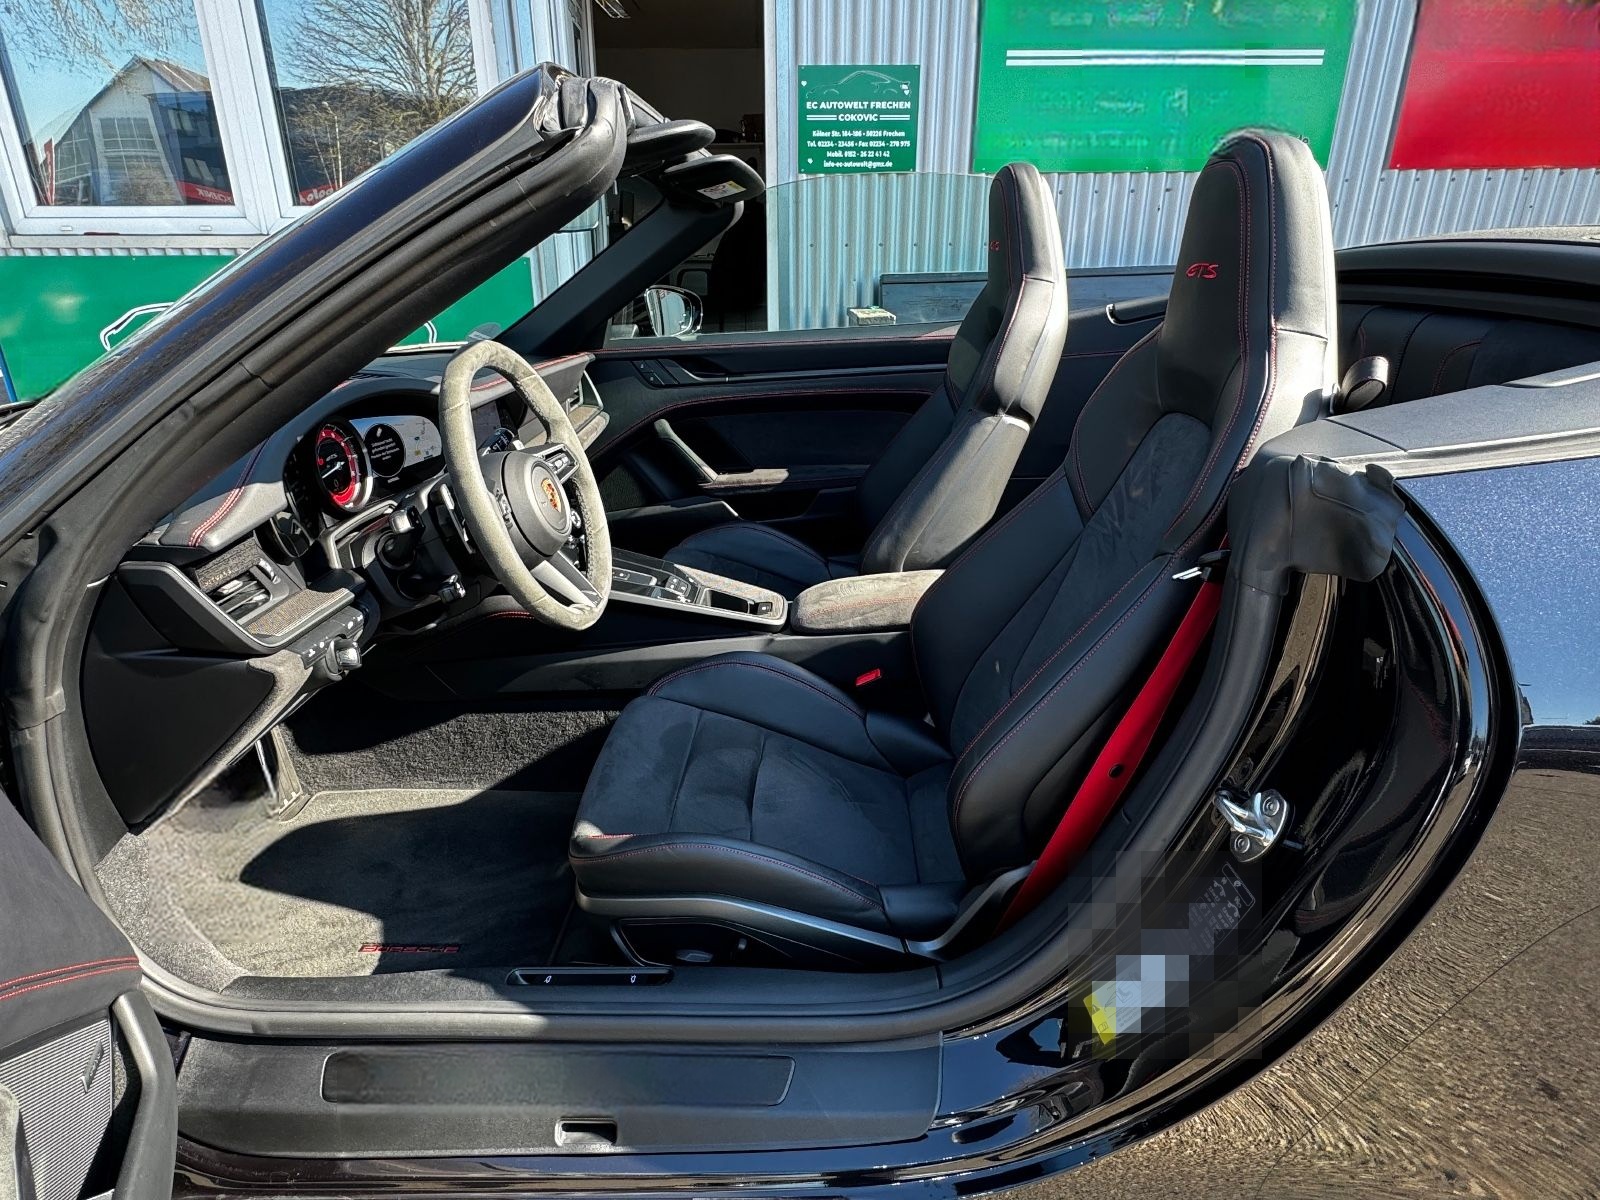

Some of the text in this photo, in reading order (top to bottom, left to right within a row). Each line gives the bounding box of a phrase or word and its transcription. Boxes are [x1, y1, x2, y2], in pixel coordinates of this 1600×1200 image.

[806, 101, 911, 109] EC AUTOWELT FRECHEN
[838, 113, 878, 121] COKOVIC
[883, 129, 905, 137] Frechen
[1186, 262, 1219, 279] GTS
